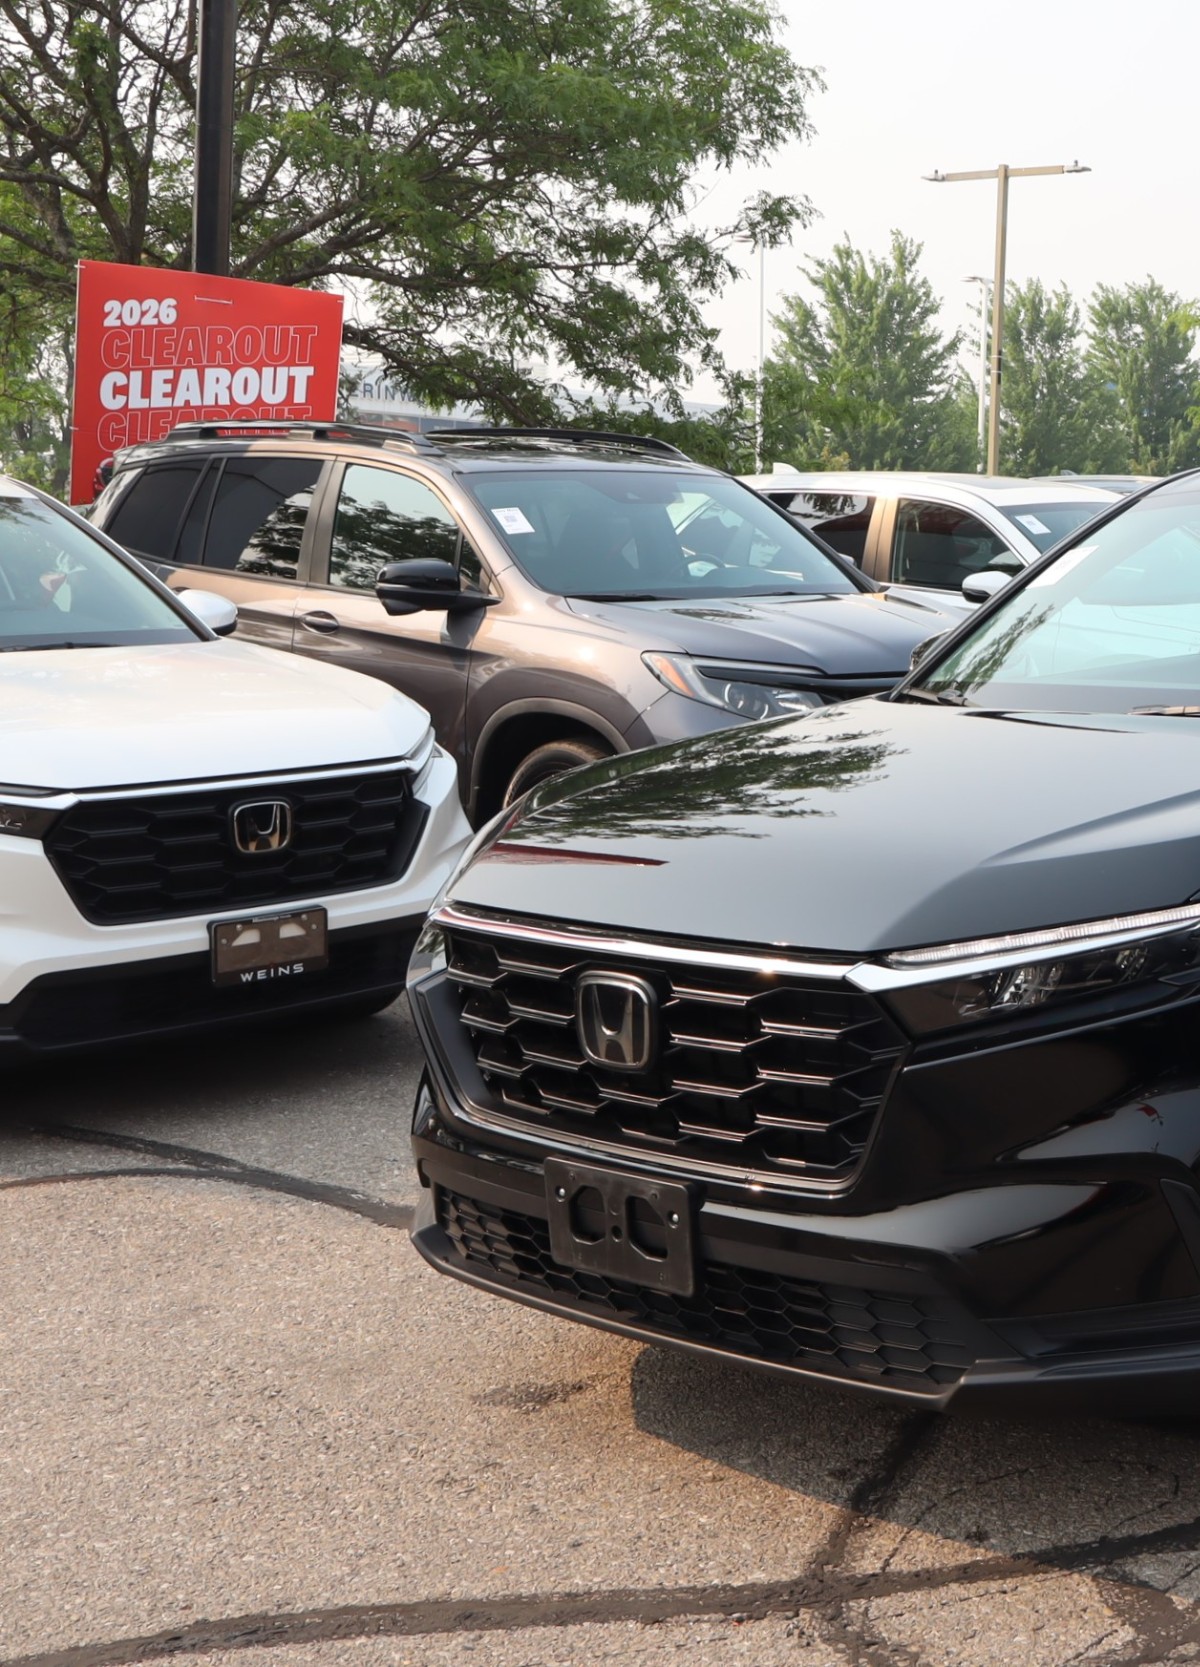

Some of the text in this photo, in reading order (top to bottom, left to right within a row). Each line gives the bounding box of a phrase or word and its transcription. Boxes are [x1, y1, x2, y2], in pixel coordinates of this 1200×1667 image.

[103, 298, 177, 327] 2026
[101, 325, 318, 369] CLEAROUT
[100, 366, 314, 411] CLEAROUT
[240, 962, 304, 983] WEINS
